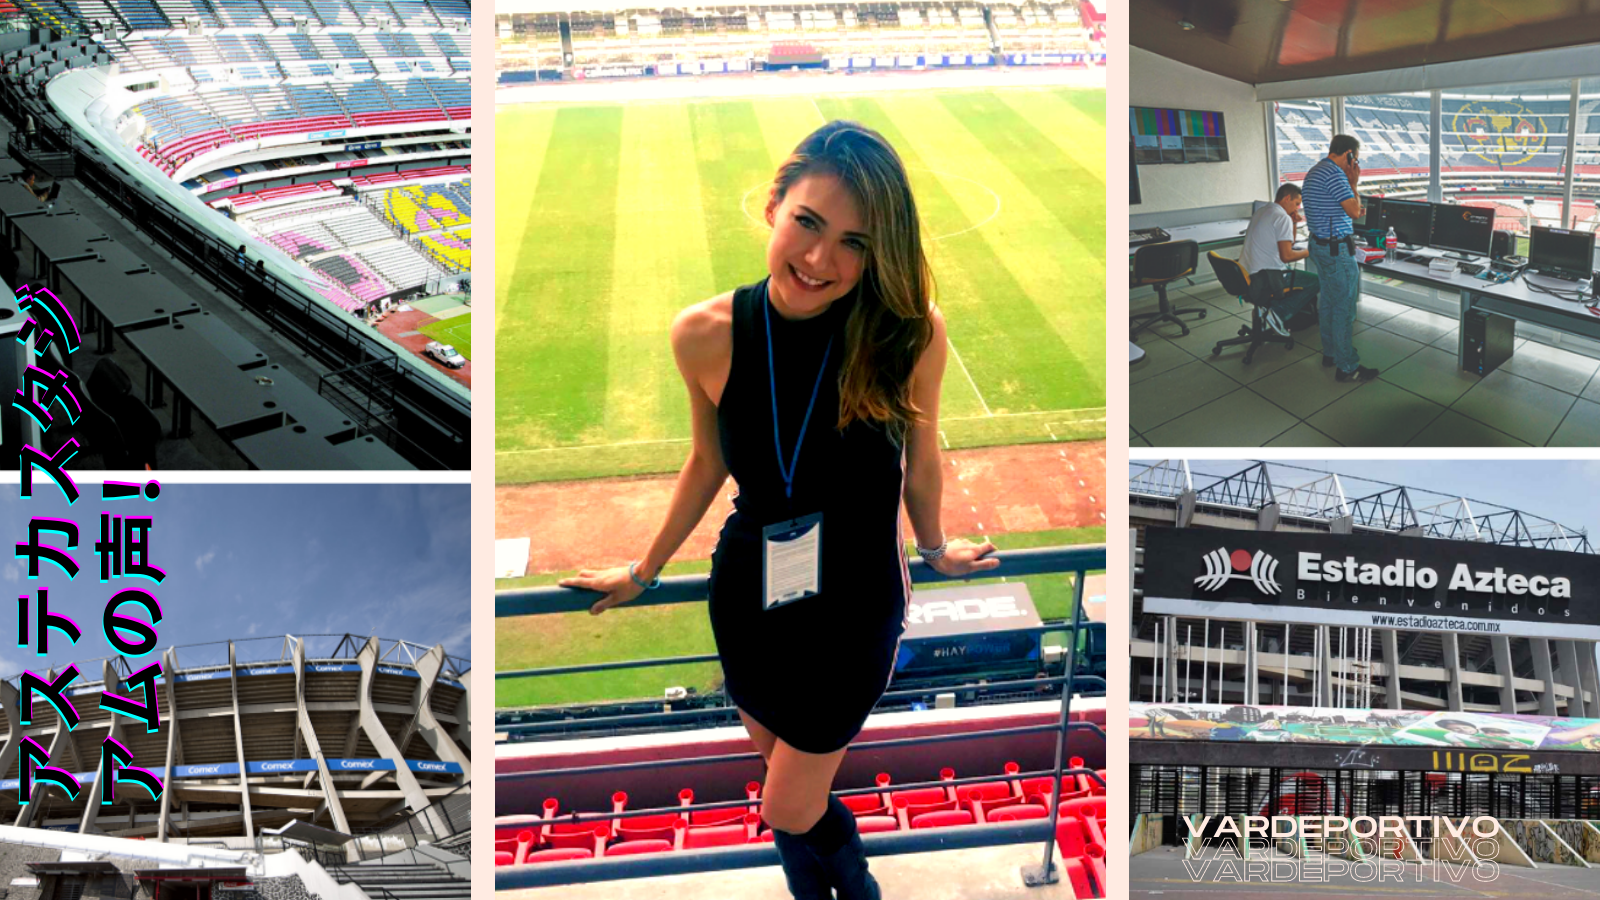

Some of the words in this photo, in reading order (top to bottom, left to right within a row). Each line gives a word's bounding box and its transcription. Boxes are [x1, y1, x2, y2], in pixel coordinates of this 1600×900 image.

[1297, 551, 1438, 590] Estadio
[1448, 563, 1571, 598] Azteca
[1371, 614, 1500, 632] www.estadioazteca.com.mx
[186, 672, 214, 681] Comex
[250, 667, 278, 676] Comex
[188, 764, 220, 774] Comex
[261, 761, 295, 771] Comex
[341, 760, 374, 769] Comex
[417, 761, 447, 771] Comex
